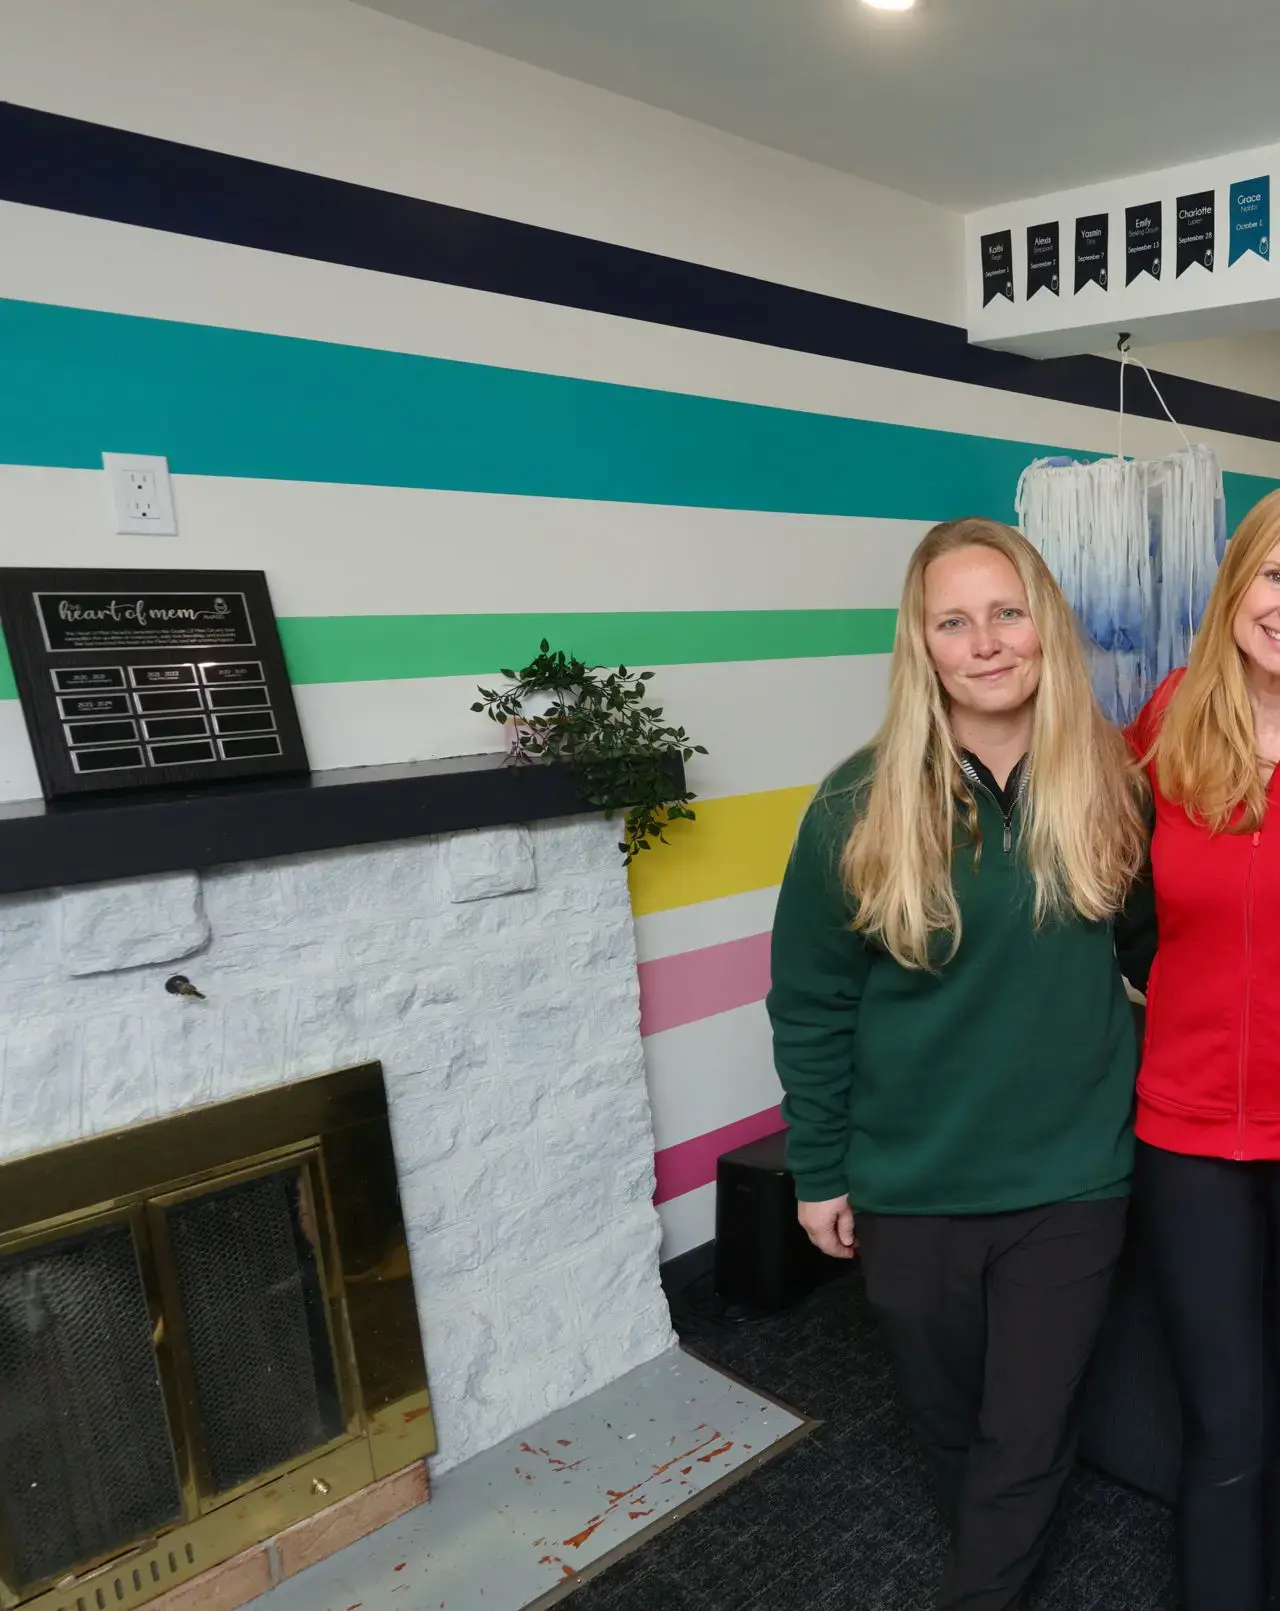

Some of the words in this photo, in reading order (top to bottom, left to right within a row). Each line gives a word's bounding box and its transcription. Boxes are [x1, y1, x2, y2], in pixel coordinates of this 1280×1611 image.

[1237, 193, 1261, 205] Grace
[1179, 206, 1212, 220] Charlotte
[1135, 218, 1152, 229] Emily
[1236, 221, 1258, 231] October
[1081, 228, 1102, 238] Yasmin
[1178, 234, 1204, 245] September
[1205, 232, 1213, 240] 28
[1034, 237, 1052, 246] Alexis
[1128, 244, 1152, 254] September
[1153, 241, 1160, 249] 13
[1077, 254, 1101, 263] September
[58, 600, 133, 622] heart
[125, 600, 147, 625] of
[149, 609, 199, 620] mem
